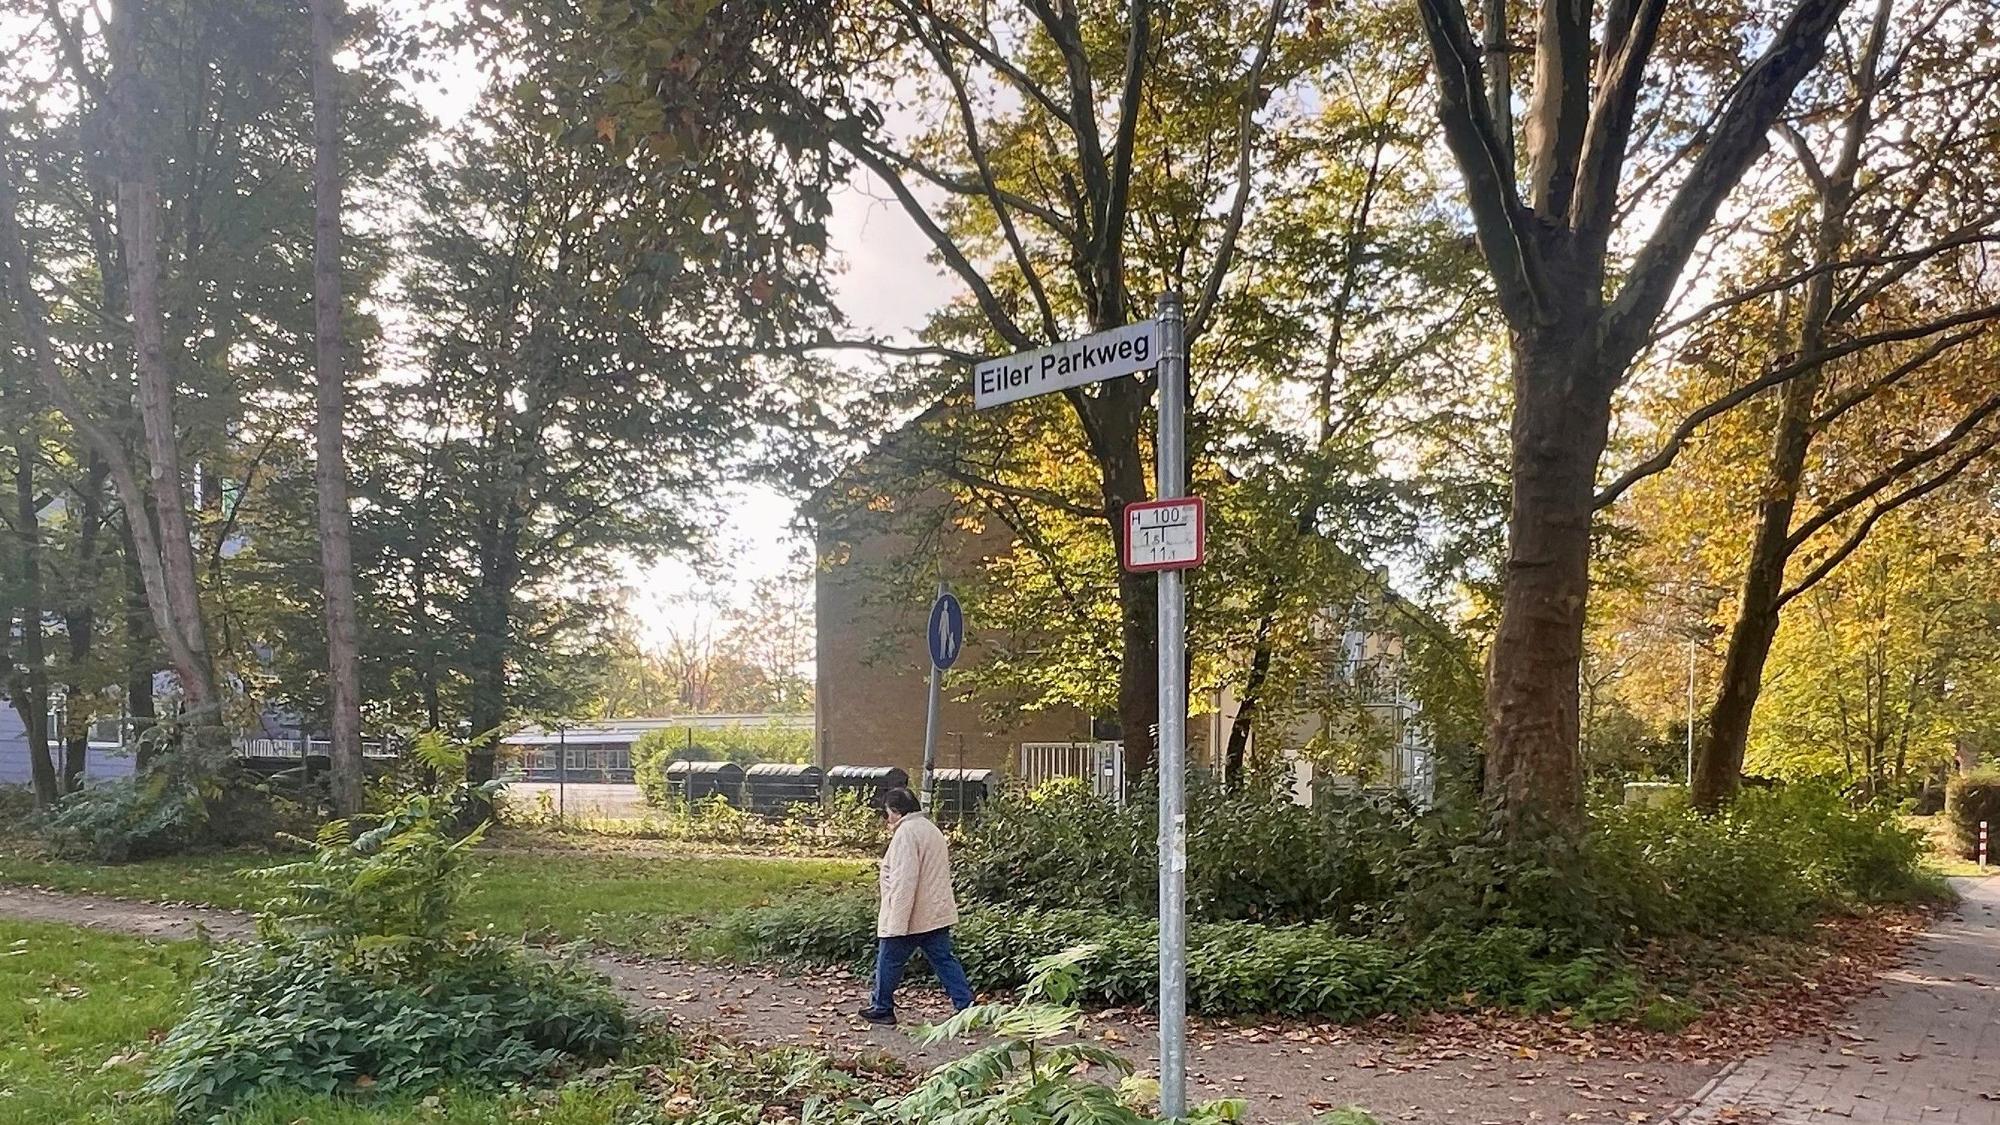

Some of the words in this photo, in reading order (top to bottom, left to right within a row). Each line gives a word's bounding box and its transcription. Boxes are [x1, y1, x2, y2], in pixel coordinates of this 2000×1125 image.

[981, 364, 1033, 395] Eiler
[1041, 335, 1149, 380] Parkweg
[1132, 512, 1141, 525] H
[1153, 507, 1180, 524] 100
